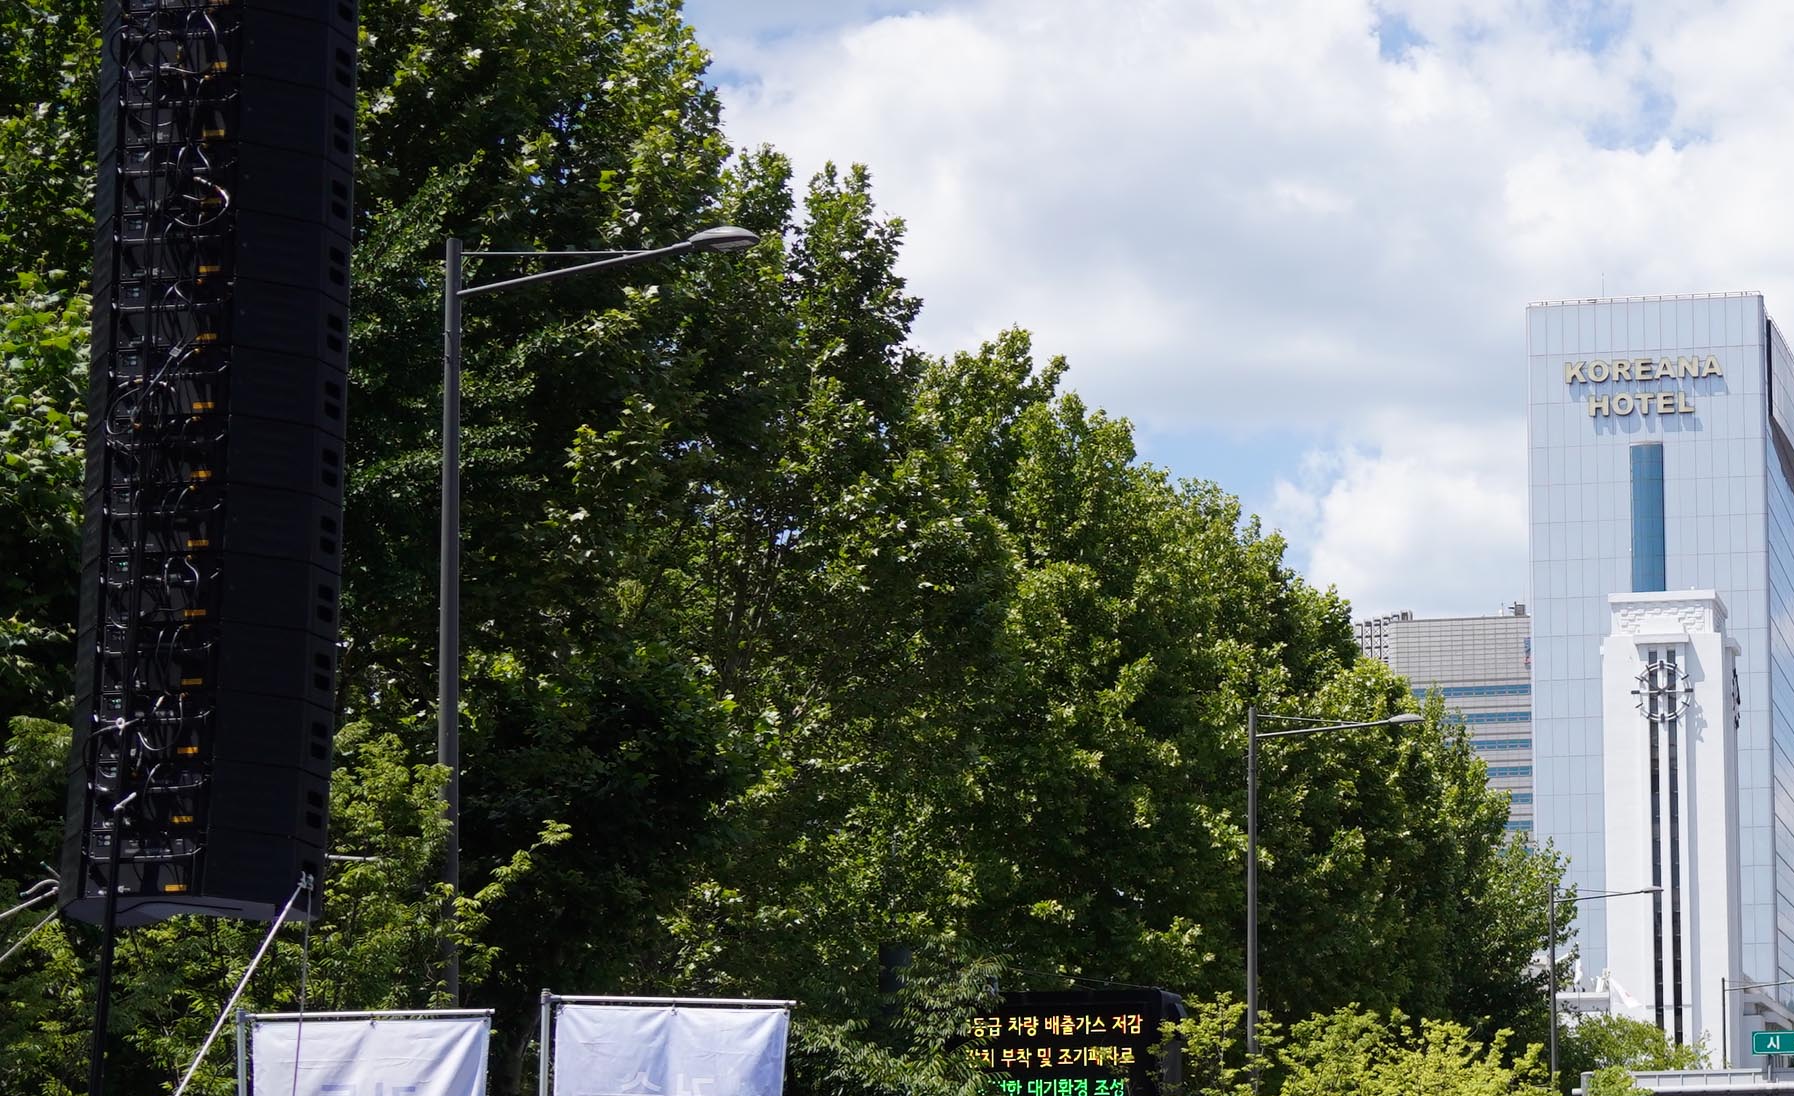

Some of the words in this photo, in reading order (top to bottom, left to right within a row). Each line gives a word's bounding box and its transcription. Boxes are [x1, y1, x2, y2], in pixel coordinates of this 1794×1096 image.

[1565, 354, 1724, 384] KOREANA
[1588, 391, 1695, 417] HOTEL
[1008, 1015, 1038, 1036] 차량
[1045, 1014, 1106, 1035] 배출가스
[1113, 1013, 1143, 1035] 저감
[1001, 1048, 1033, 1068] 부착
[1037, 1047, 1052, 1067] 및
